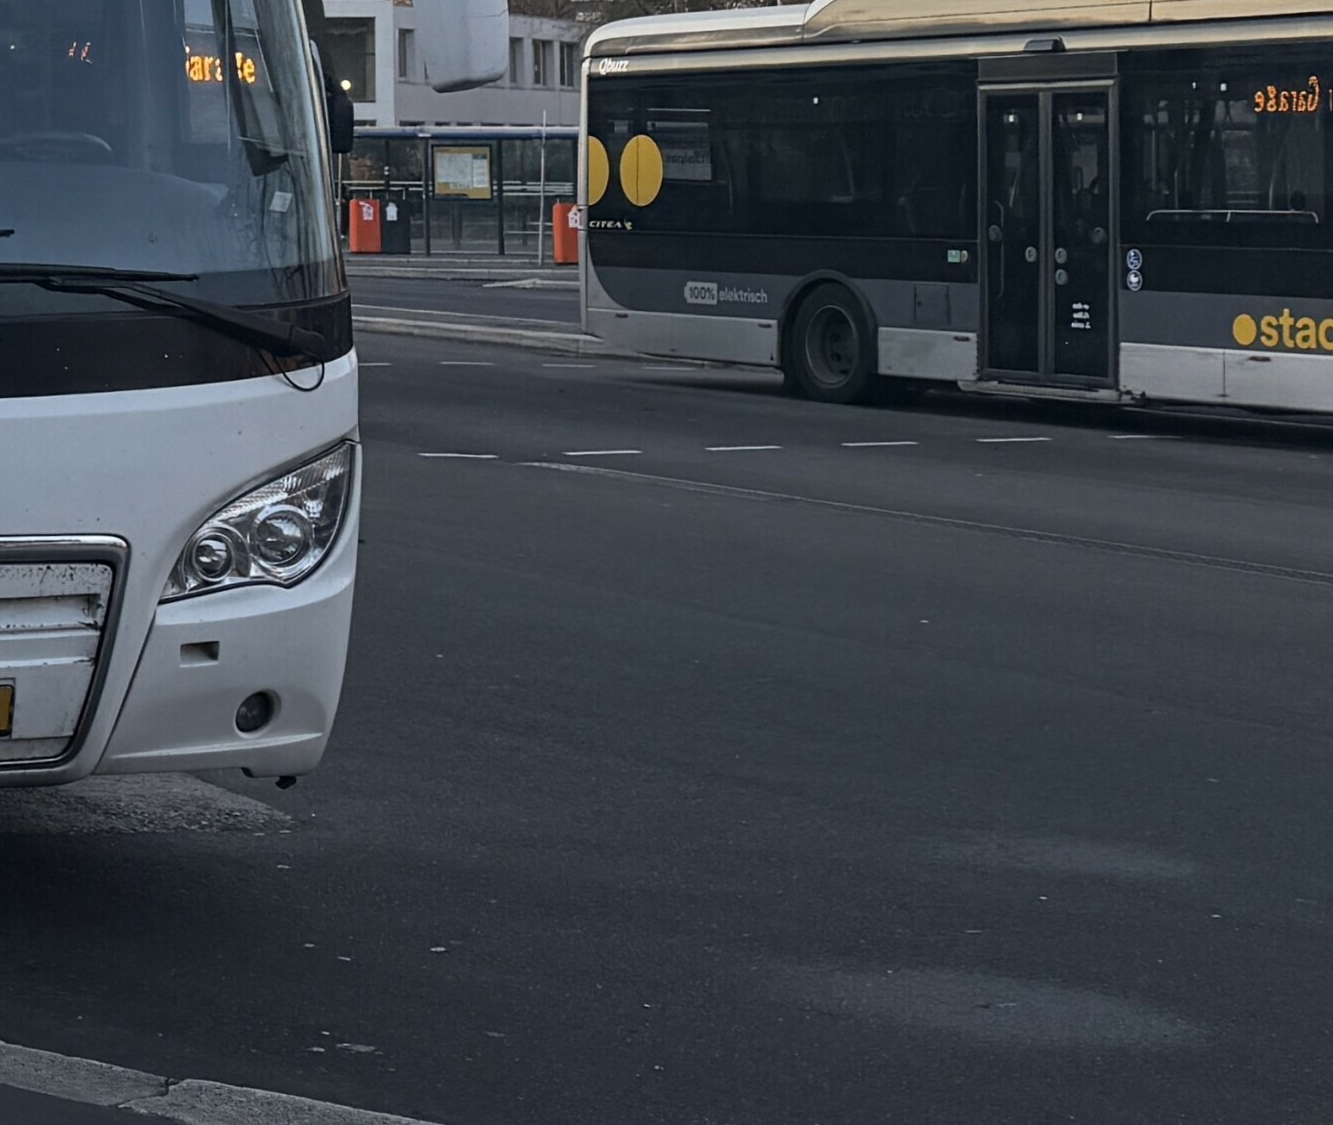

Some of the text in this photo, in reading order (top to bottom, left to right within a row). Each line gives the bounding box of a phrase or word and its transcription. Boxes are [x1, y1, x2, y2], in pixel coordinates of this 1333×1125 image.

[598, 58, 629, 75] Qbuzz
[589, 220, 622, 229] CITEA
[688, 286, 768, 303] 100% elektrisch
